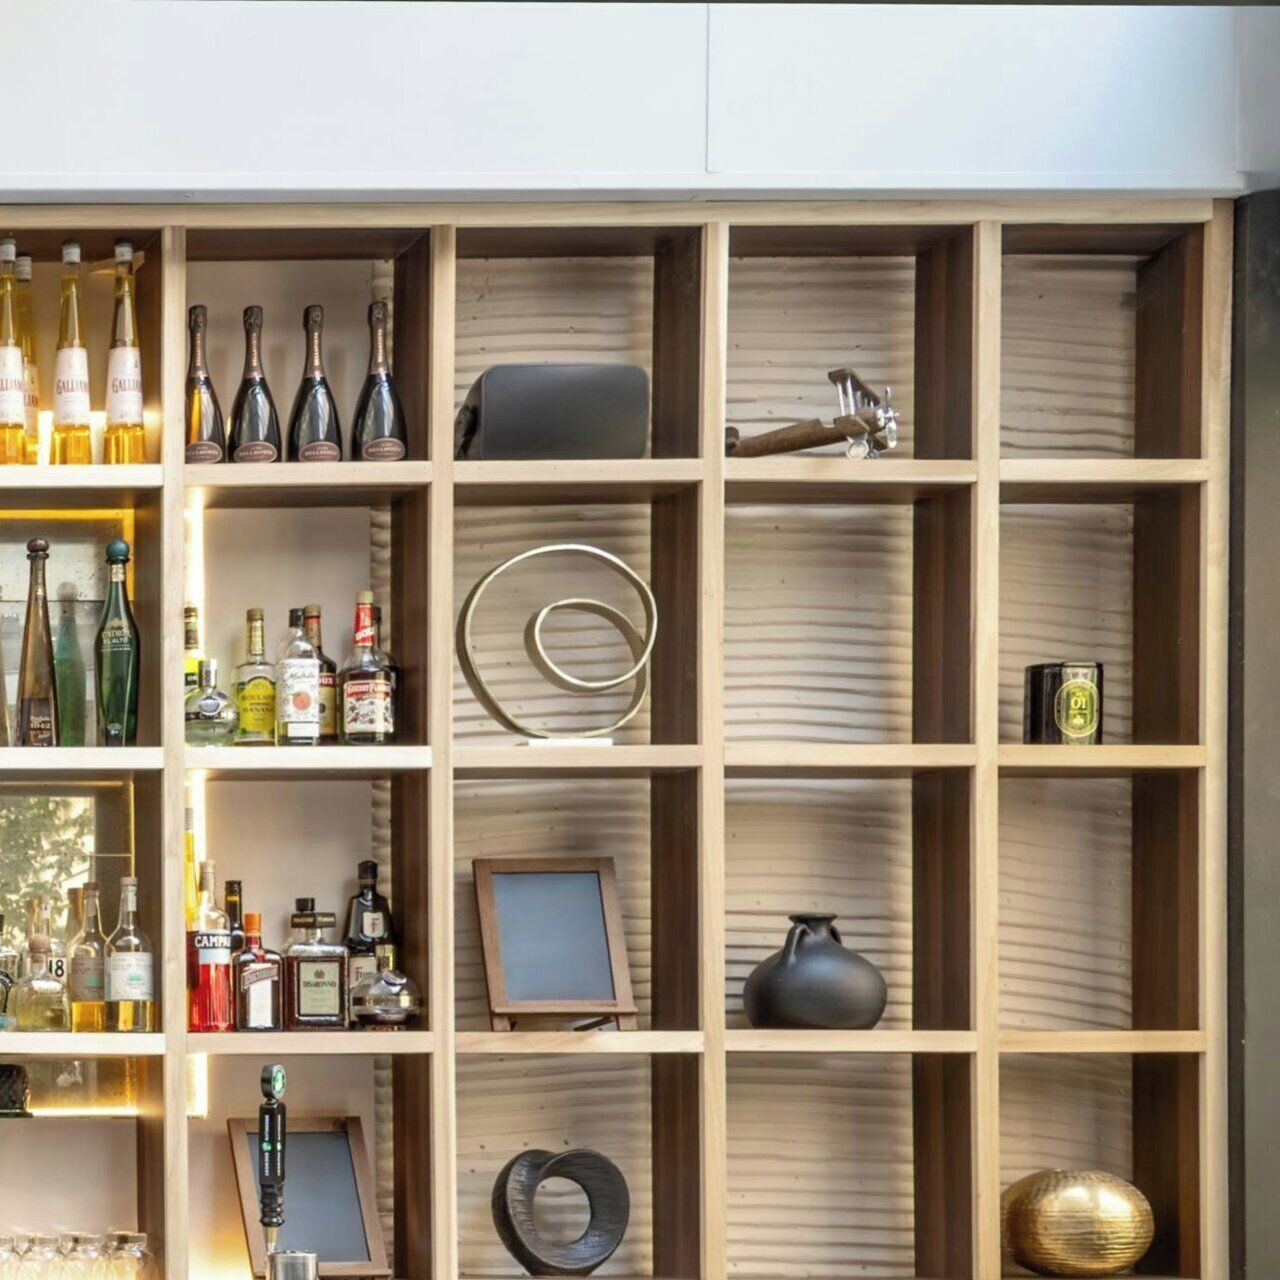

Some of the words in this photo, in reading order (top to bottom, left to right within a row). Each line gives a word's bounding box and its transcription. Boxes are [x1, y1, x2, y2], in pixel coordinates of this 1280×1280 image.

[56, 378, 89, 395] GALLIAN
[195, 935, 231, 948] CAMPA
[302, 980, 337, 989] DISARONNO
